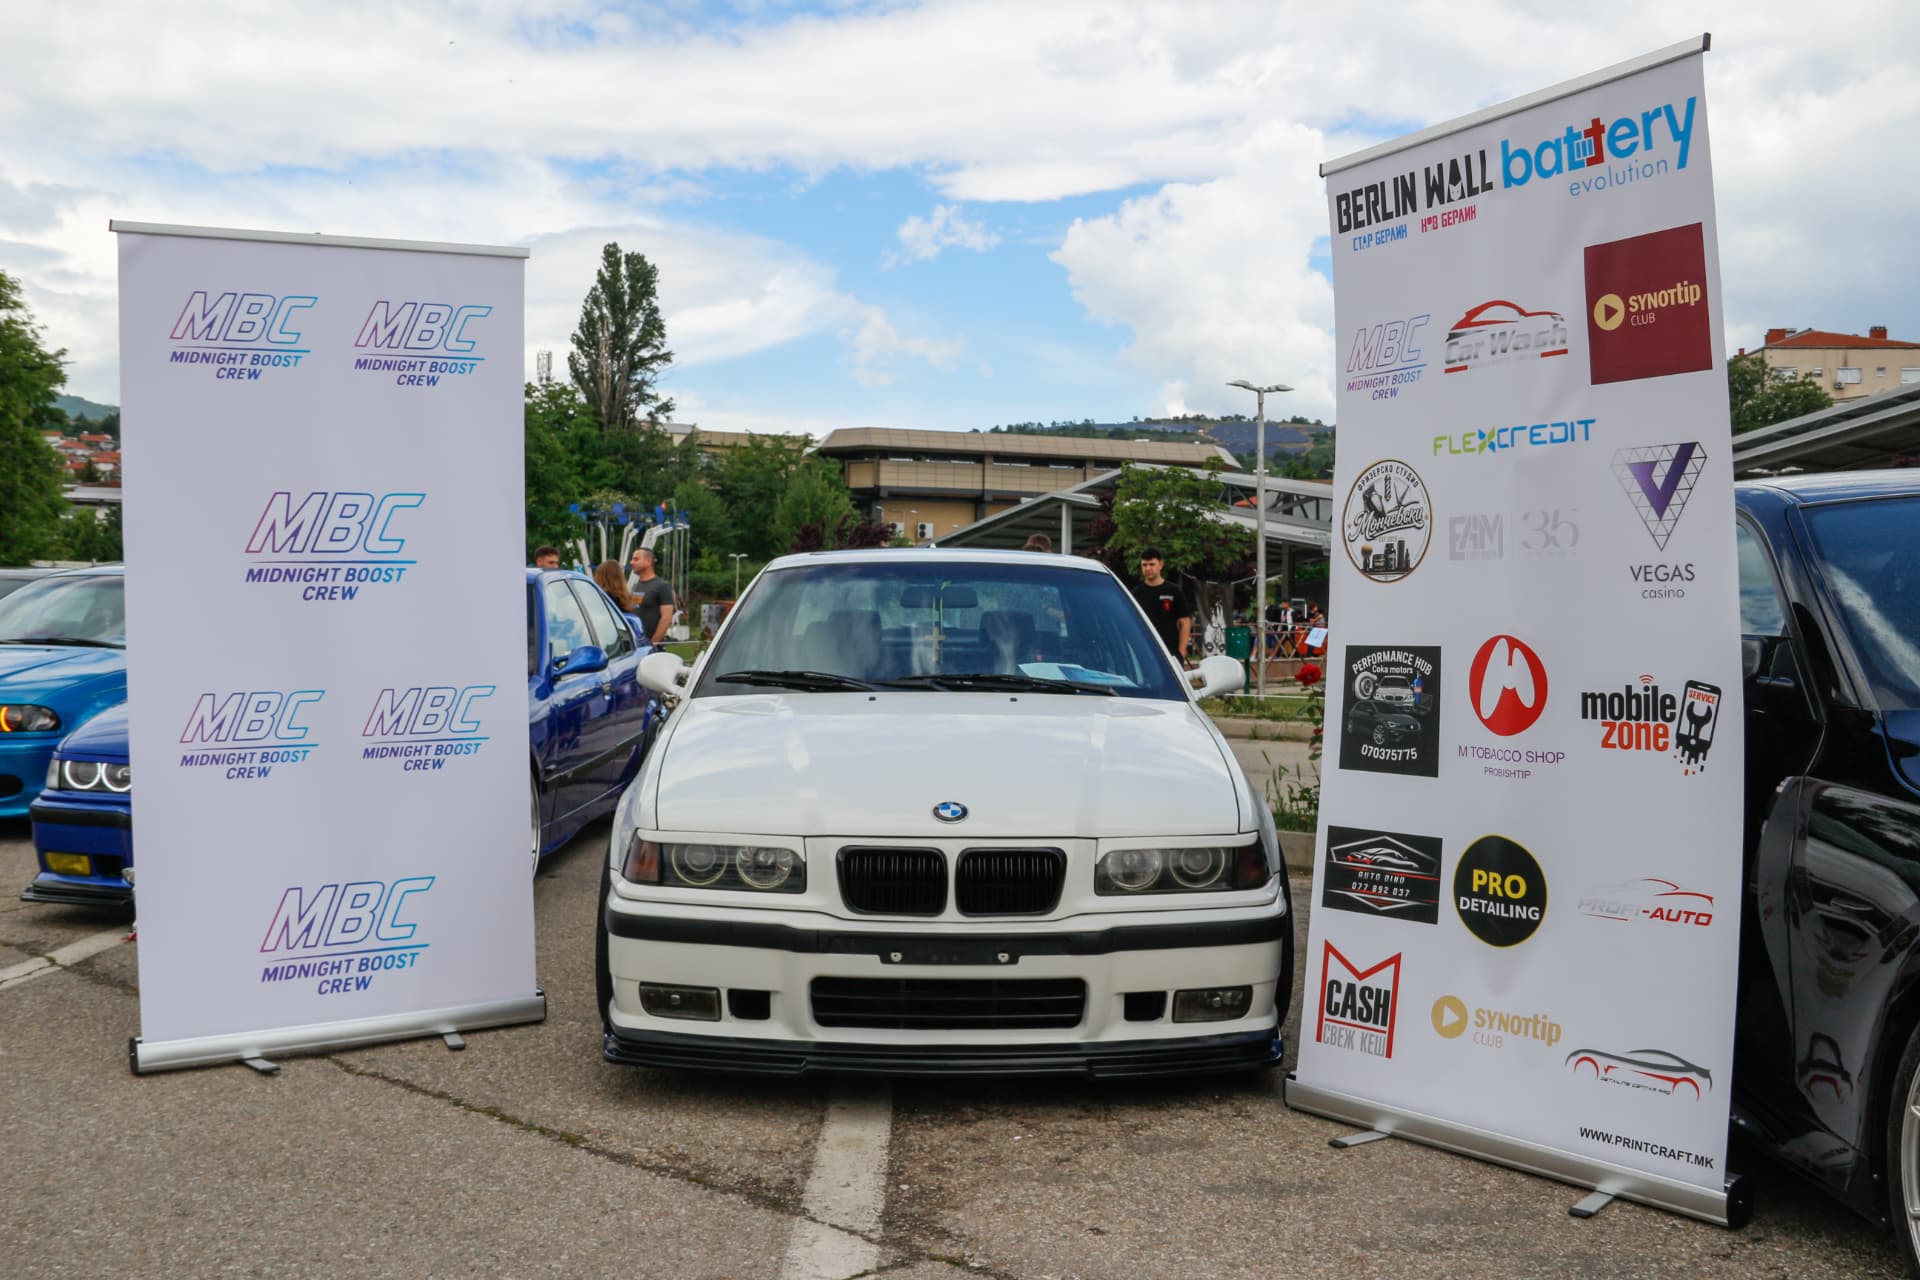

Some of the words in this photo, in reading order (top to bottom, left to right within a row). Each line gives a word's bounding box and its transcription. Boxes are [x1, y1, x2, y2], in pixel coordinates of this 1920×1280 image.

[1501, 96, 1697, 188] battery
[1569, 158, 1668, 197] evolution
[1336, 171, 1418, 234] BERLIN
[1424, 149, 1493, 209] WALL
[169, 290, 319, 345] MBC
[354, 300, 493, 353] MBC
[1630, 312, 1656, 327] CLUB
[1346, 314, 1431, 373] MBC
[169, 350, 248, 367] MIDNIGHT
[249, 352, 302, 369] BOOST
[354, 357, 427, 373] MIDNIGHT
[428, 360, 477, 375] BOOST
[215, 366, 263, 381] CREW
[396, 373, 441, 388] CREW
[1346, 375, 1390, 392] MIDNIGHT
[1391, 370, 1423, 385] BOOST
[1372, 387, 1400, 401] CREW
[244, 491, 427, 555] MBC
[245, 567, 342, 583] MIDNIGHT
[344, 567, 407, 584] BOOST
[1629, 563, 1696, 583] VEGAS
[302, 585, 360, 602] CREW
[1641, 585, 1685, 600] casino
[1352, 650, 1415, 675] PERFORMANCE
[1414, 656, 1433, 676] HUB
[1371, 664, 1389, 673] Coka
[1389, 665, 1414, 674] motors
[1581, 684, 1677, 723] mobile
[1688, 689, 1717, 705] SERVICE
[179, 689, 326, 744] MBC
[361, 685, 497, 737] MBC
[1601, 721, 1670, 752] zone
[180, 751, 257, 767] MIDNIGHT
[259, 749, 310, 764] BOOST
[362, 744, 432, 760] MIDNIGHT
[433, 742, 482, 757] BOOST
[1361, 744, 1418, 761] 070375775
[1458, 745, 1469, 758] M
[1470, 747, 1522, 763] TOBACCO
[1525, 749, 1566, 764] SHOP
[225, 765, 272, 780] CREW
[403, 757, 446, 772] CREW
[1484, 766, 1532, 780] PROBISHTIP
[1472, 868, 1527, 900] PRO
[260, 875, 436, 953] MBC
[1459, 896, 1540, 922] DETAILING
[261, 958, 355, 983] MIDNIGHT
[358, 952, 420, 973] BOOST
[317, 975, 373, 996] CREW
[1326, 979, 1391, 1027] CASH
[1323, 1022, 1355, 1050] СВЕЖ
[1360, 1030, 1386, 1058] КЕШ
[1473, 1031, 1503, 1049] CLUB
[1579, 1126, 1715, 1169] WWW.PRINTCRAFT.MK
